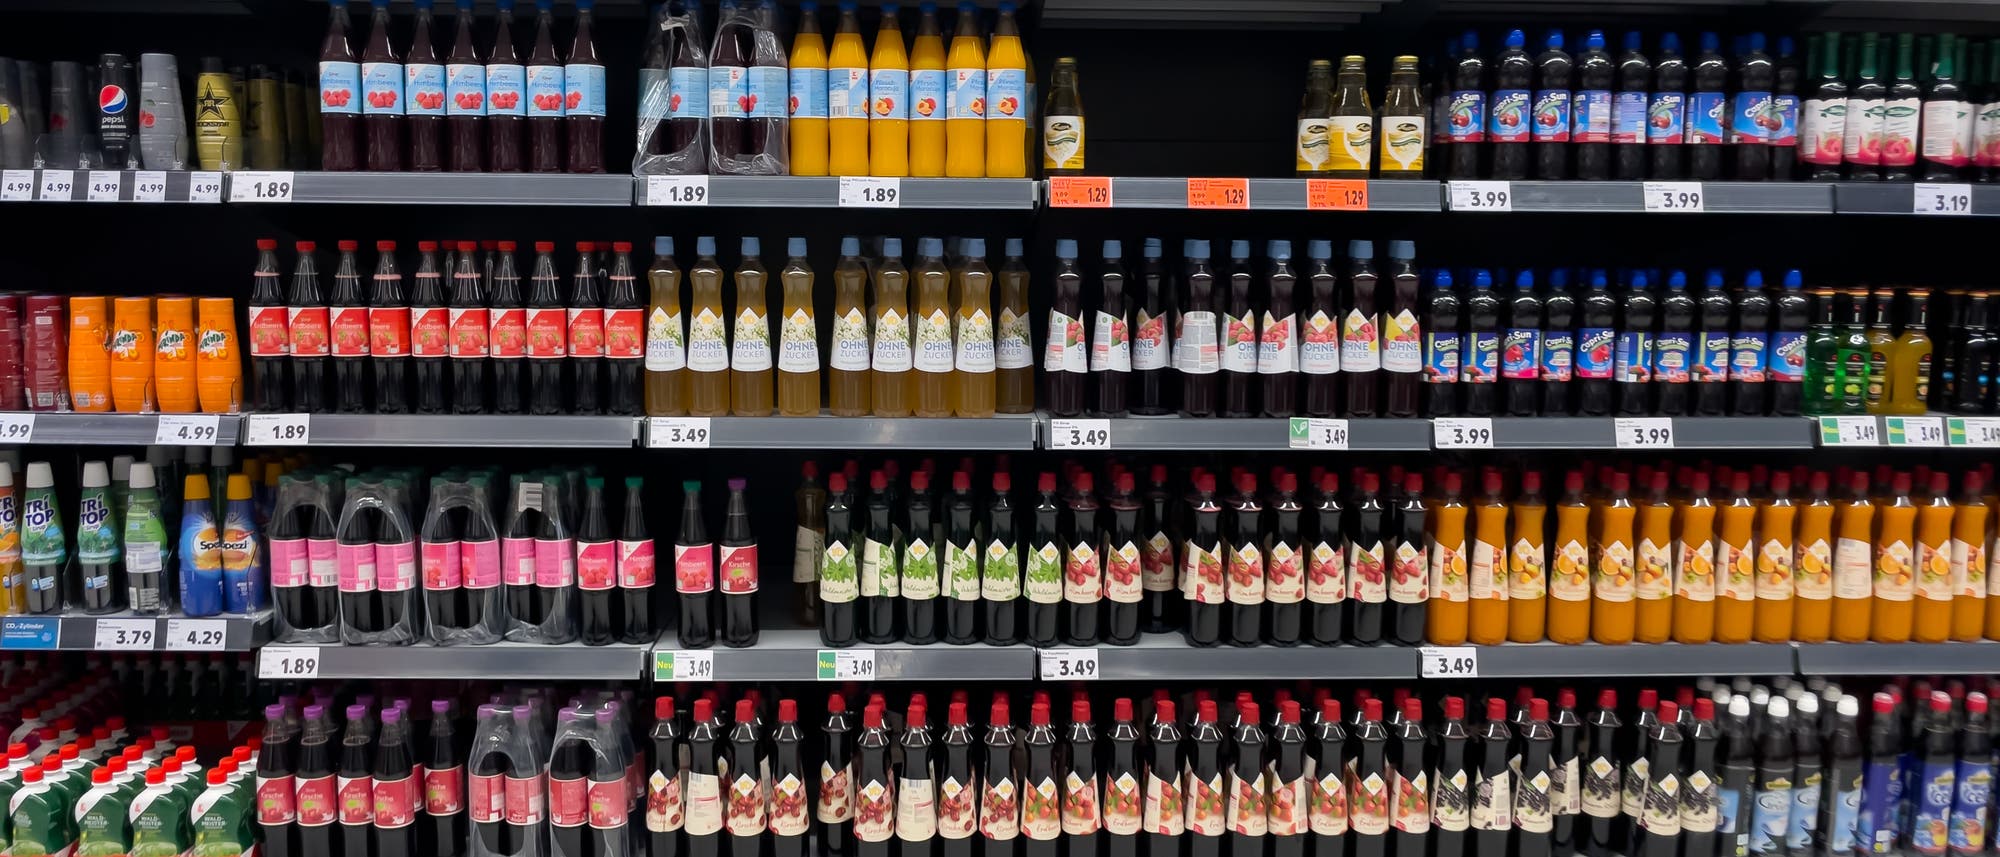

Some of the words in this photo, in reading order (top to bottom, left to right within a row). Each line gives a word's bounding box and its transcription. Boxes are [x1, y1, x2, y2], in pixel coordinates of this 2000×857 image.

[102, 116, 124, 124] pepsi
[7, 182, 31, 192] 4.99
[46, 183, 70, 192] 4.99
[94, 183, 118, 192] 4.99
[140, 183, 164, 192] 4.99
[196, 184, 219, 193] 4.99
[254, 182, 290, 198] 1.89
[670, 186, 706, 202] 1.89
[862, 188, 896, 202] 1.89
[1088, 188, 1107, 202] 1.29
[1224, 189, 1244, 204] 1.29
[1344, 190, 1364, 205] 1.29
[1470, 192, 1507, 206] 3.99
[1663, 193, 1700, 208] 3.99
[1935, 195, 1968, 212] 3.19
[693, 340, 722, 349] OHNE
[735, 340, 763, 349] OHNE
[786, 342, 814, 350] OHNE
[841, 340, 868, 350] OHNE
[877, 342, 905, 350] OHNE
[924, 342, 952, 350] OHNE
[965, 342, 993, 350] OHNE
[1305, 343, 1334, 352] OHNE
[1390, 341, 1418, 350] OHNE
[785, 351, 815, 359] ZUCKER
[877, 351, 906, 359] ZUCKER
[1304, 352, 1335, 360] ZUCKER
[1389, 351, 1418, 359] ZUCKER
[178, 426, 215, 440] 4.99
[272, 425, 306, 439] 1.89
[671, 428, 707, 442] 3.49
[1070, 430, 1108, 446] 3.49
[1326, 430, 1346, 444] 3.49
[1454, 428, 1490, 444] 3.99
[1634, 428, 1670, 444] 3.99
[1855, 426, 1874, 440] 3.49
[1922, 426, 1940, 442] 3.49
[25, 509, 54, 527] TOP
[80, 508, 109, 526] TOP
[728, 560, 751, 568] Kirsche
[116, 630, 152, 645] 3.79
[187, 630, 224, 645] 4.29
[281, 658, 316, 674] 1.89
[657, 661, 674, 670] Neu
[689, 660, 710, 676] 3.49
[819, 660, 835, 669] Neu
[852, 660, 872, 676] 3.49
[1059, 660, 1096, 676] 3.49
[1438, 658, 1474, 674] 3.49
